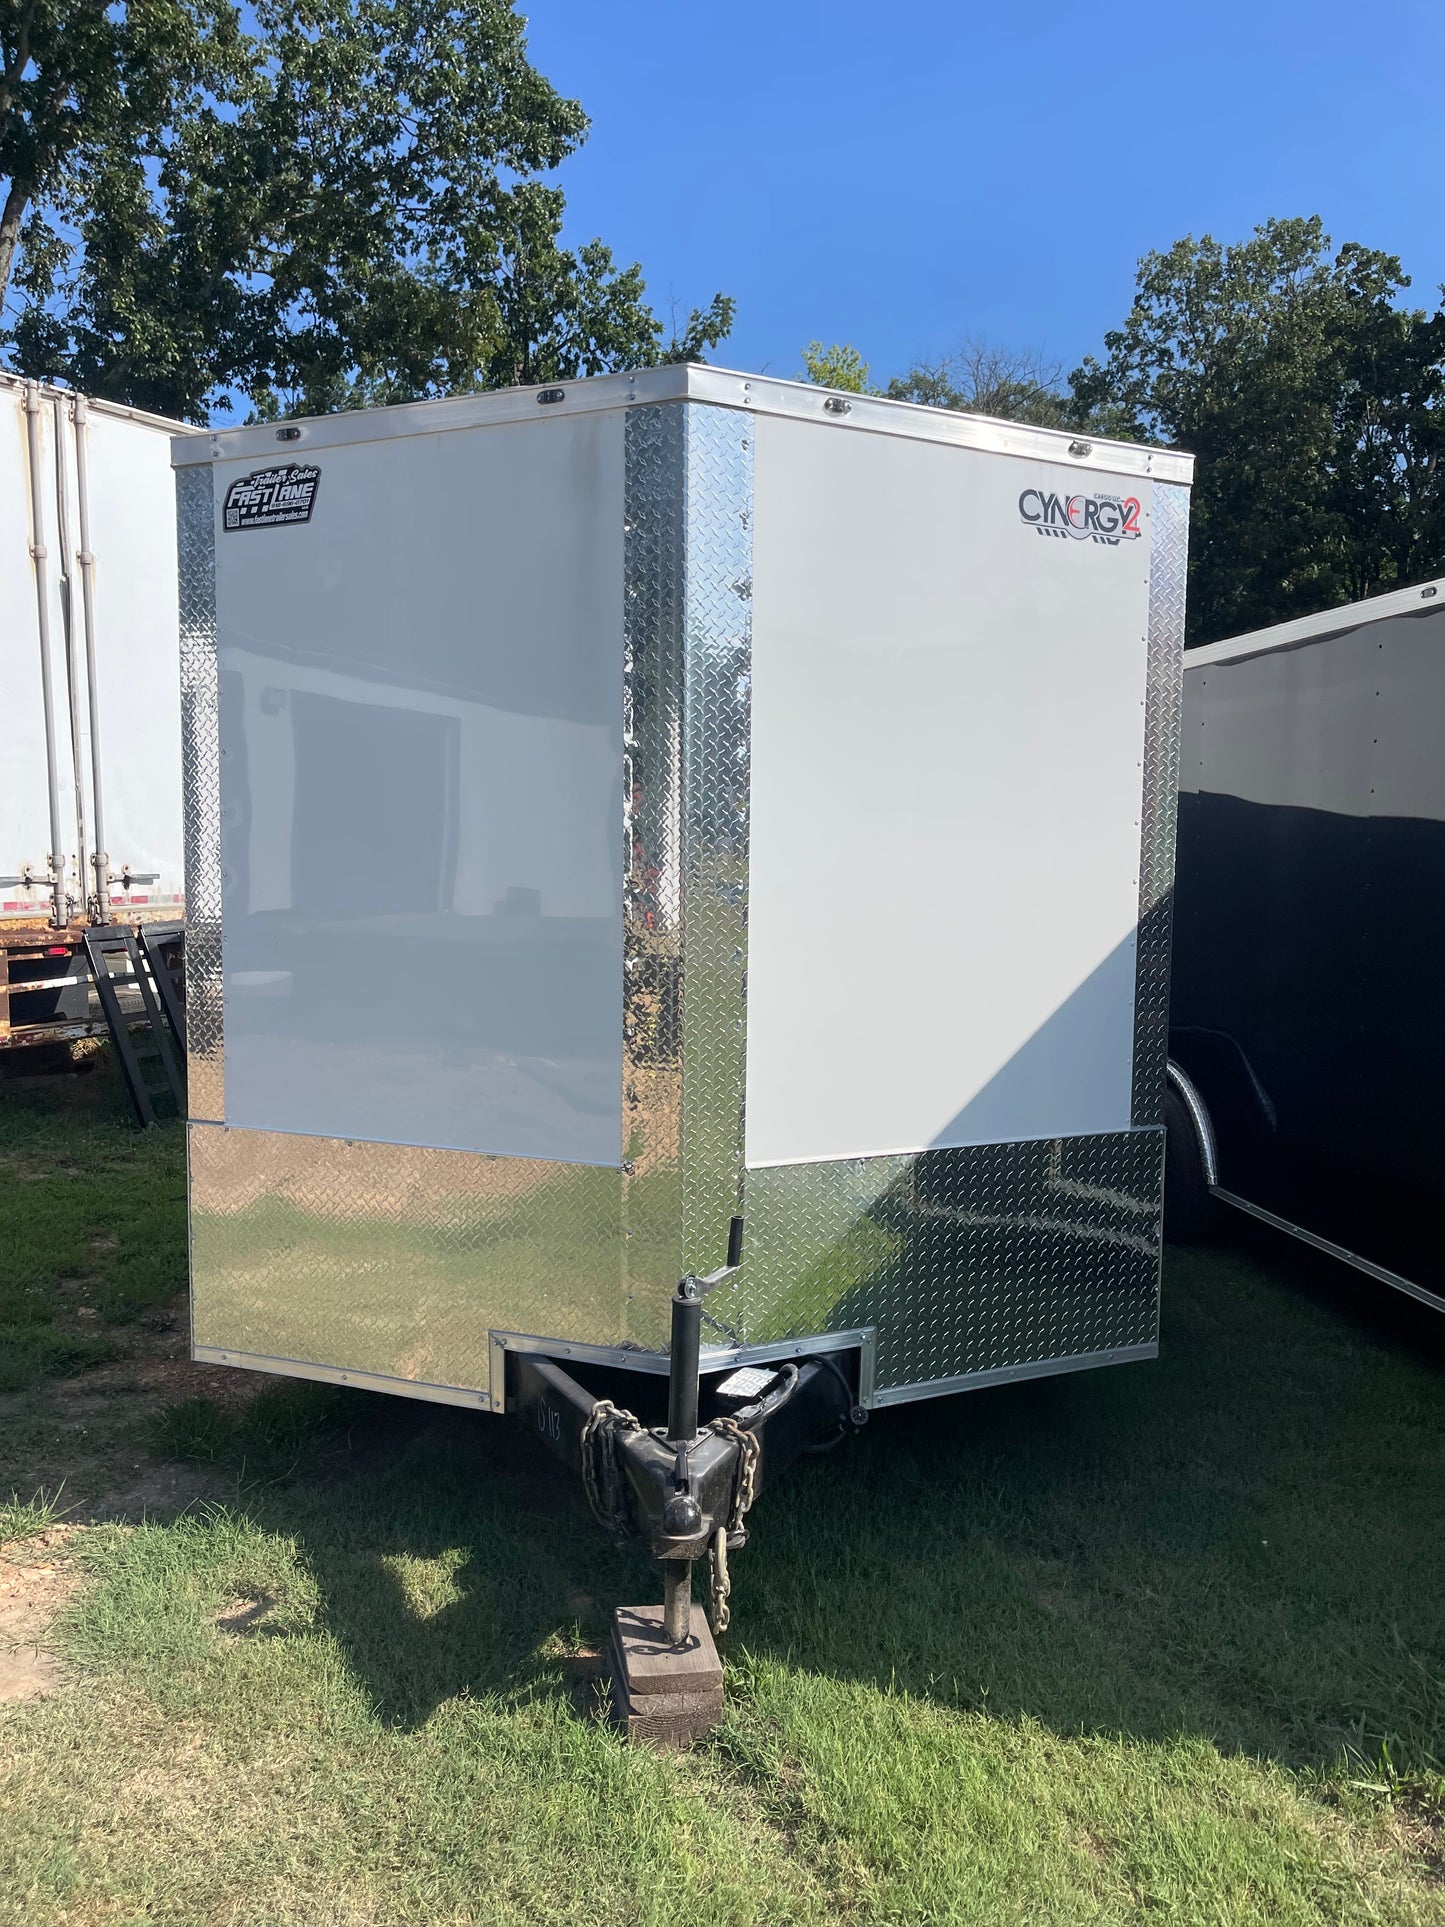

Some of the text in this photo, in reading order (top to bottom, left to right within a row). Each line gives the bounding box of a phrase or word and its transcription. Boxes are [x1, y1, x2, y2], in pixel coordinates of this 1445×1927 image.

[253, 468, 319, 487] Trailer Sales
[227, 482, 315, 508] FAST LANE
